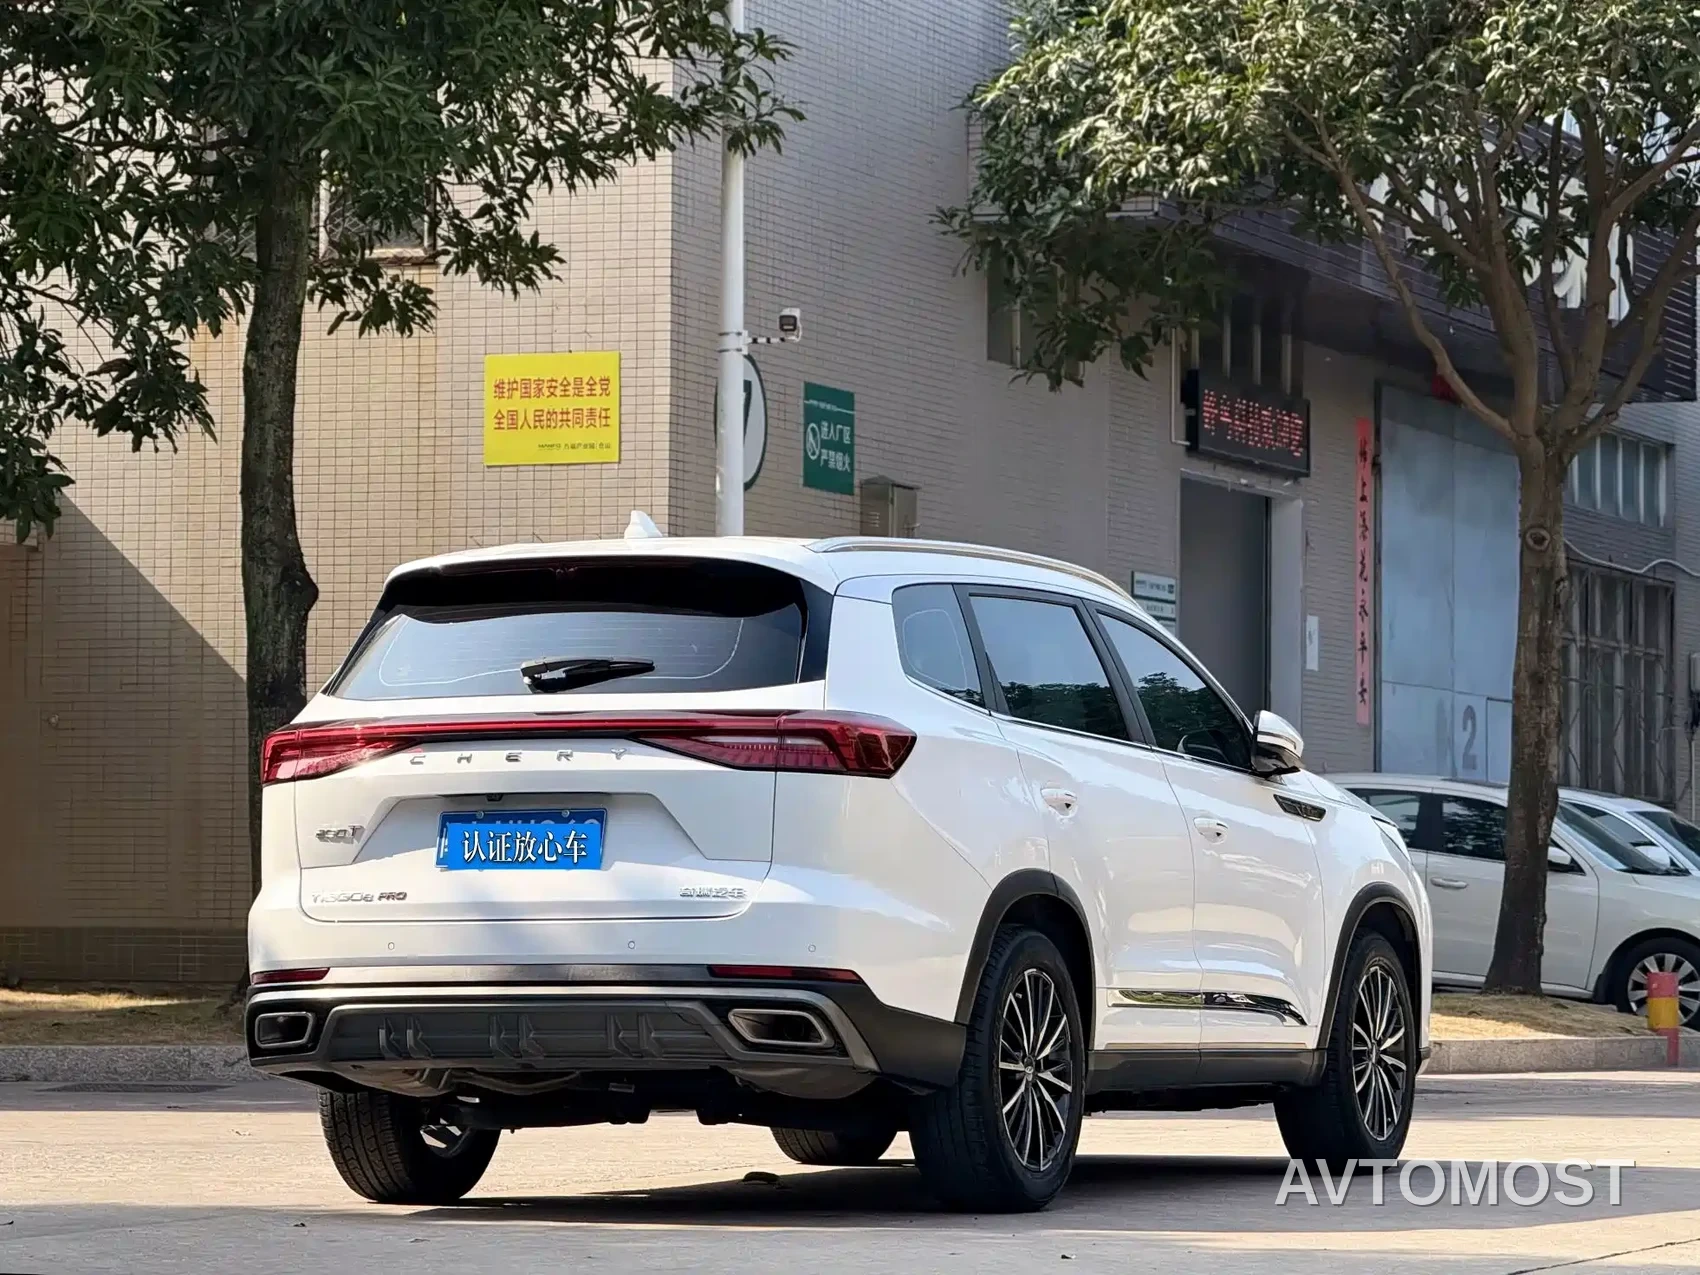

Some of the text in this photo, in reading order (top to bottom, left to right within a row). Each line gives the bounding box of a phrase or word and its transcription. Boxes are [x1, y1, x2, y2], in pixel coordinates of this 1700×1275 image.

[493, 375, 611, 400] 维护国家安全是全党
[493, 407, 611, 430] 全国人民的共同责任
[820, 449, 851, 473] 严禁烟火
[409, 747, 628, 766] CHERY
[377, 891, 408, 902] PRO
